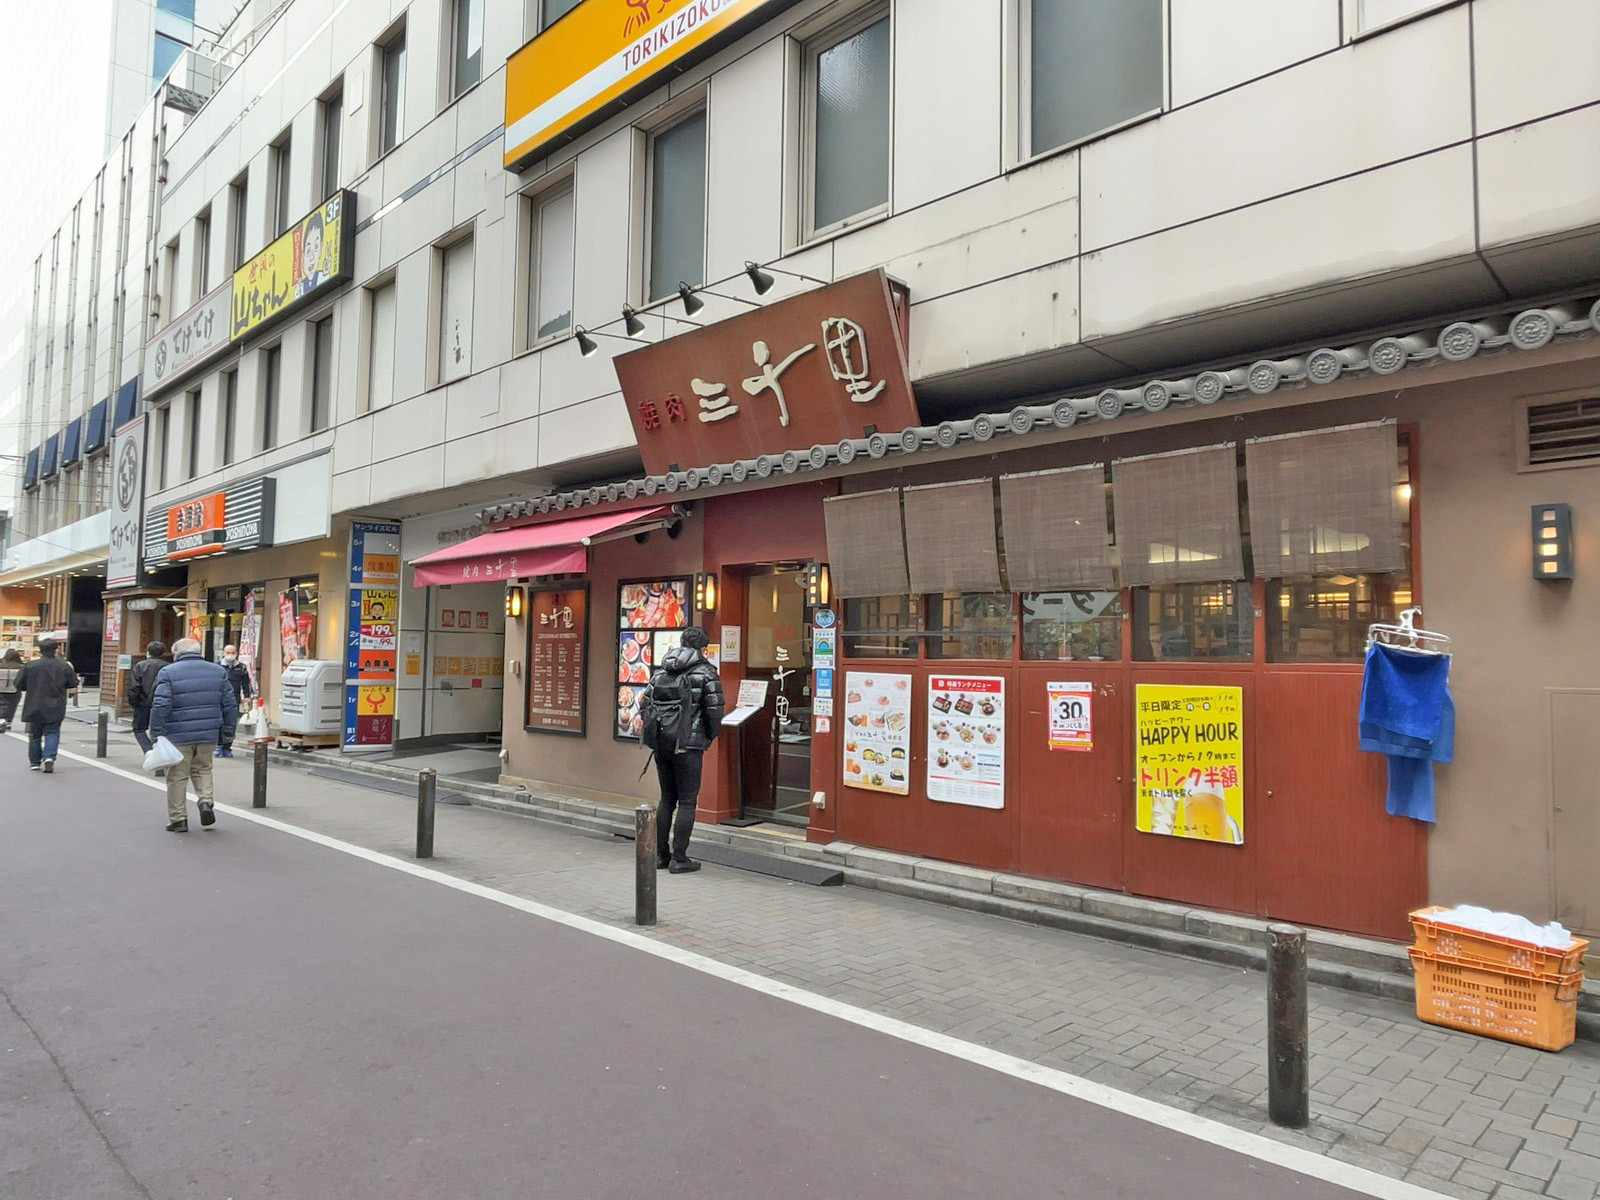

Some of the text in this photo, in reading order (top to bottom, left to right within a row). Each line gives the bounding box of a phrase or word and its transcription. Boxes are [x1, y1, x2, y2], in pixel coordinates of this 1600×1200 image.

[326, 197, 340, 223] 3F
[233, 270, 289, 336] 山ちゃん
[172, 307, 215, 354] てけてけ
[354, 523, 398, 533] サンライズビル
[1059, 701, 1083, 720] 30
[1140, 700, 1182, 712] 平日限定
[1140, 716, 1191, 726] ハッピーアワー
[1140, 722, 1239, 746] HAPPY HOUR
[1141, 765, 1240, 789] ドリンク半額
